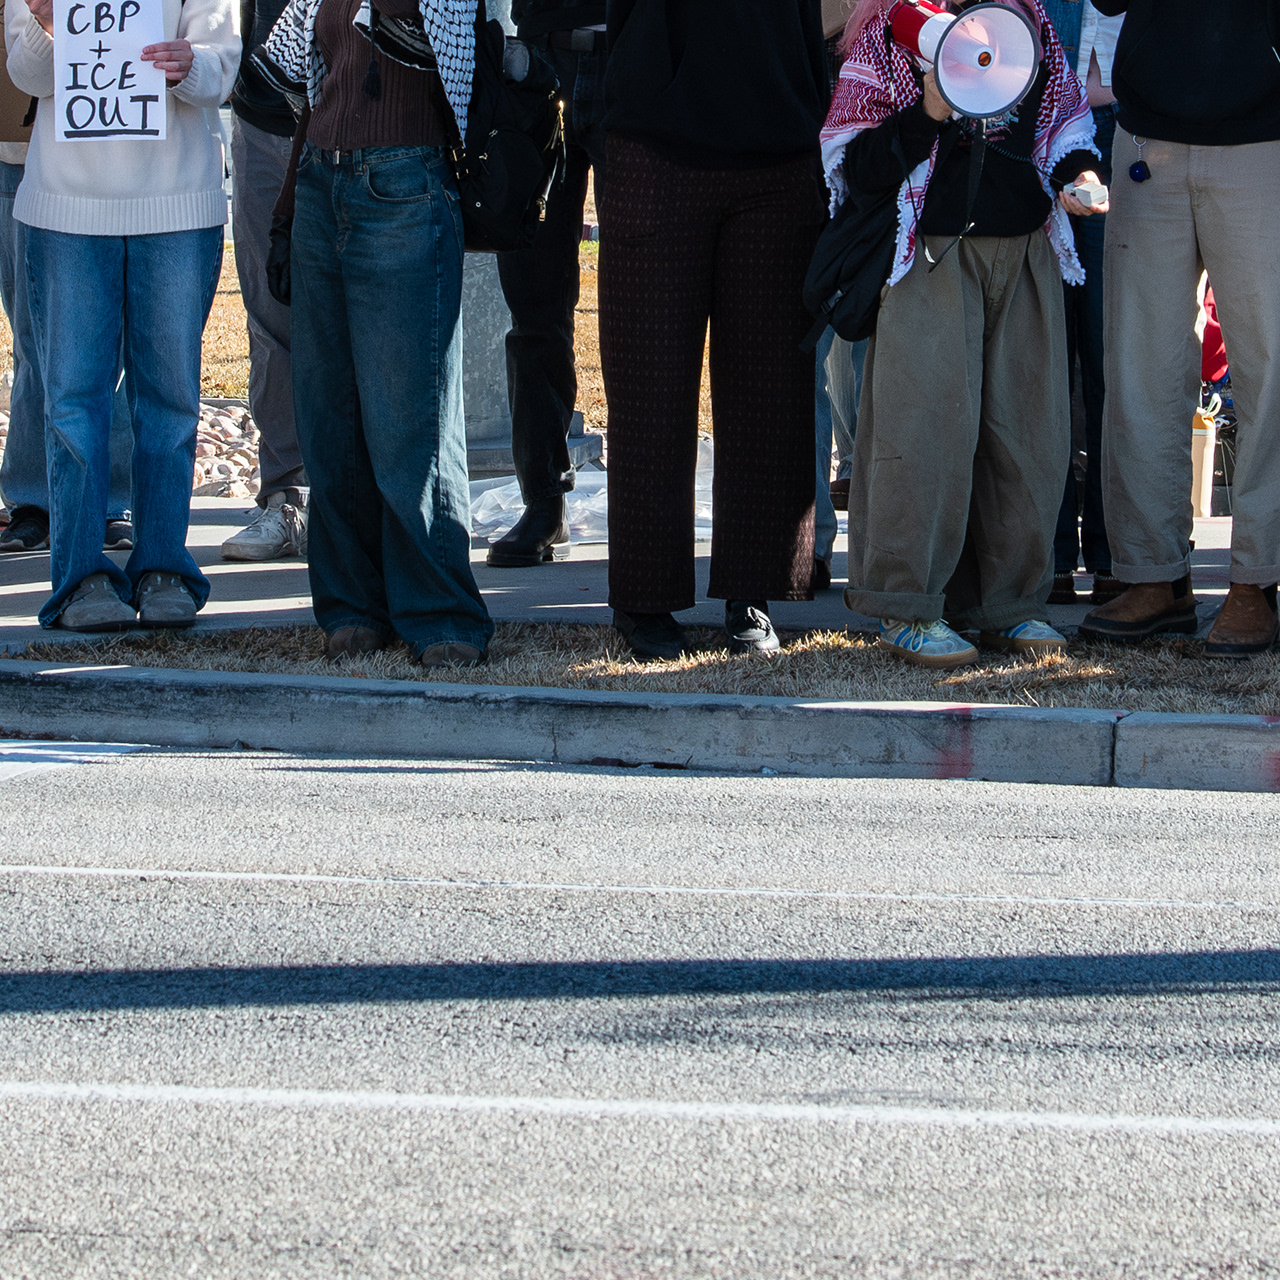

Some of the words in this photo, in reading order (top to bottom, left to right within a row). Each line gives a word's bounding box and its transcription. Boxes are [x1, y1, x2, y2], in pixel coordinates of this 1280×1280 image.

[66, 0, 140, 35] CBP
[65, 61, 137, 91] ICE
[65, 94, 160, 131] OUT
